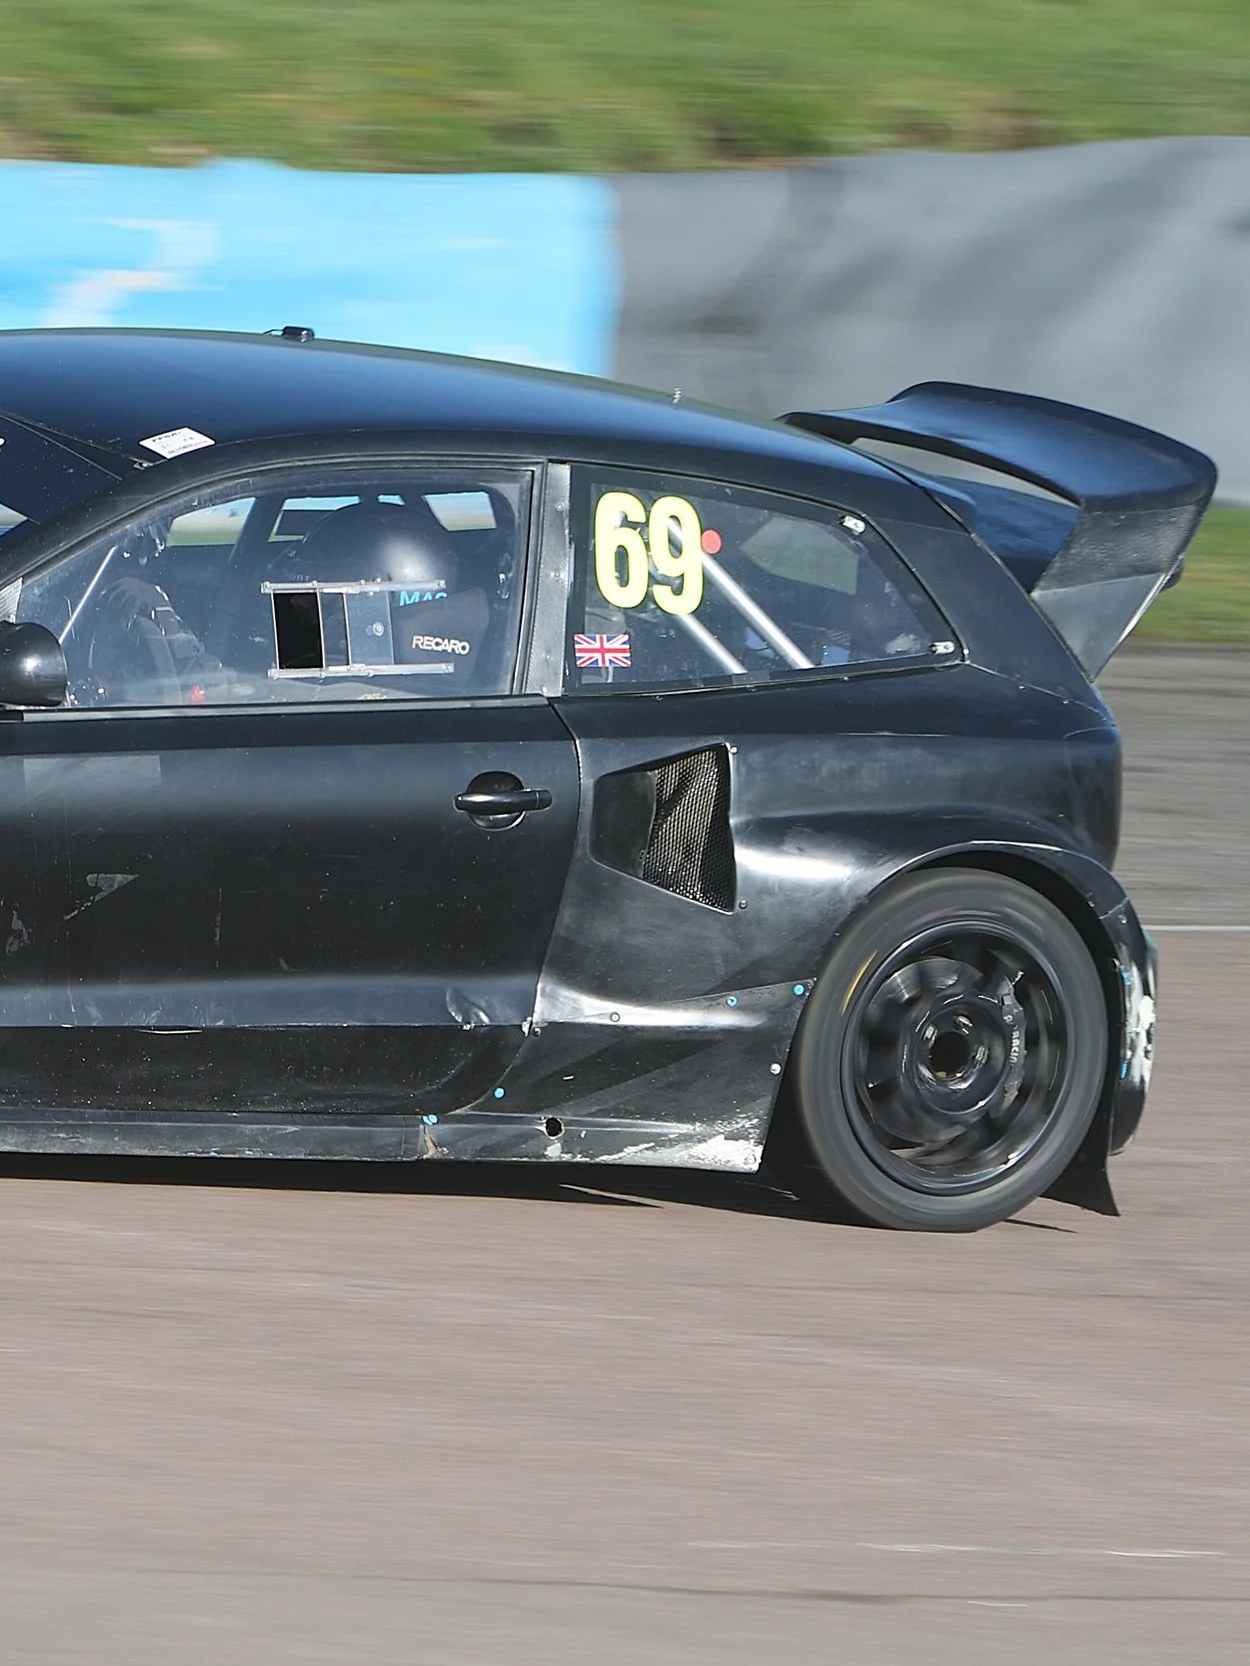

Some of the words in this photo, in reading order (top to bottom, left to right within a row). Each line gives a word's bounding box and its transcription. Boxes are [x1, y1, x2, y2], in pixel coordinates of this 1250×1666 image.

[593, 490, 705, 616] 69
[412, 635, 470, 655] RECARO
[1009, 1030, 1020, 1067] RACIN
